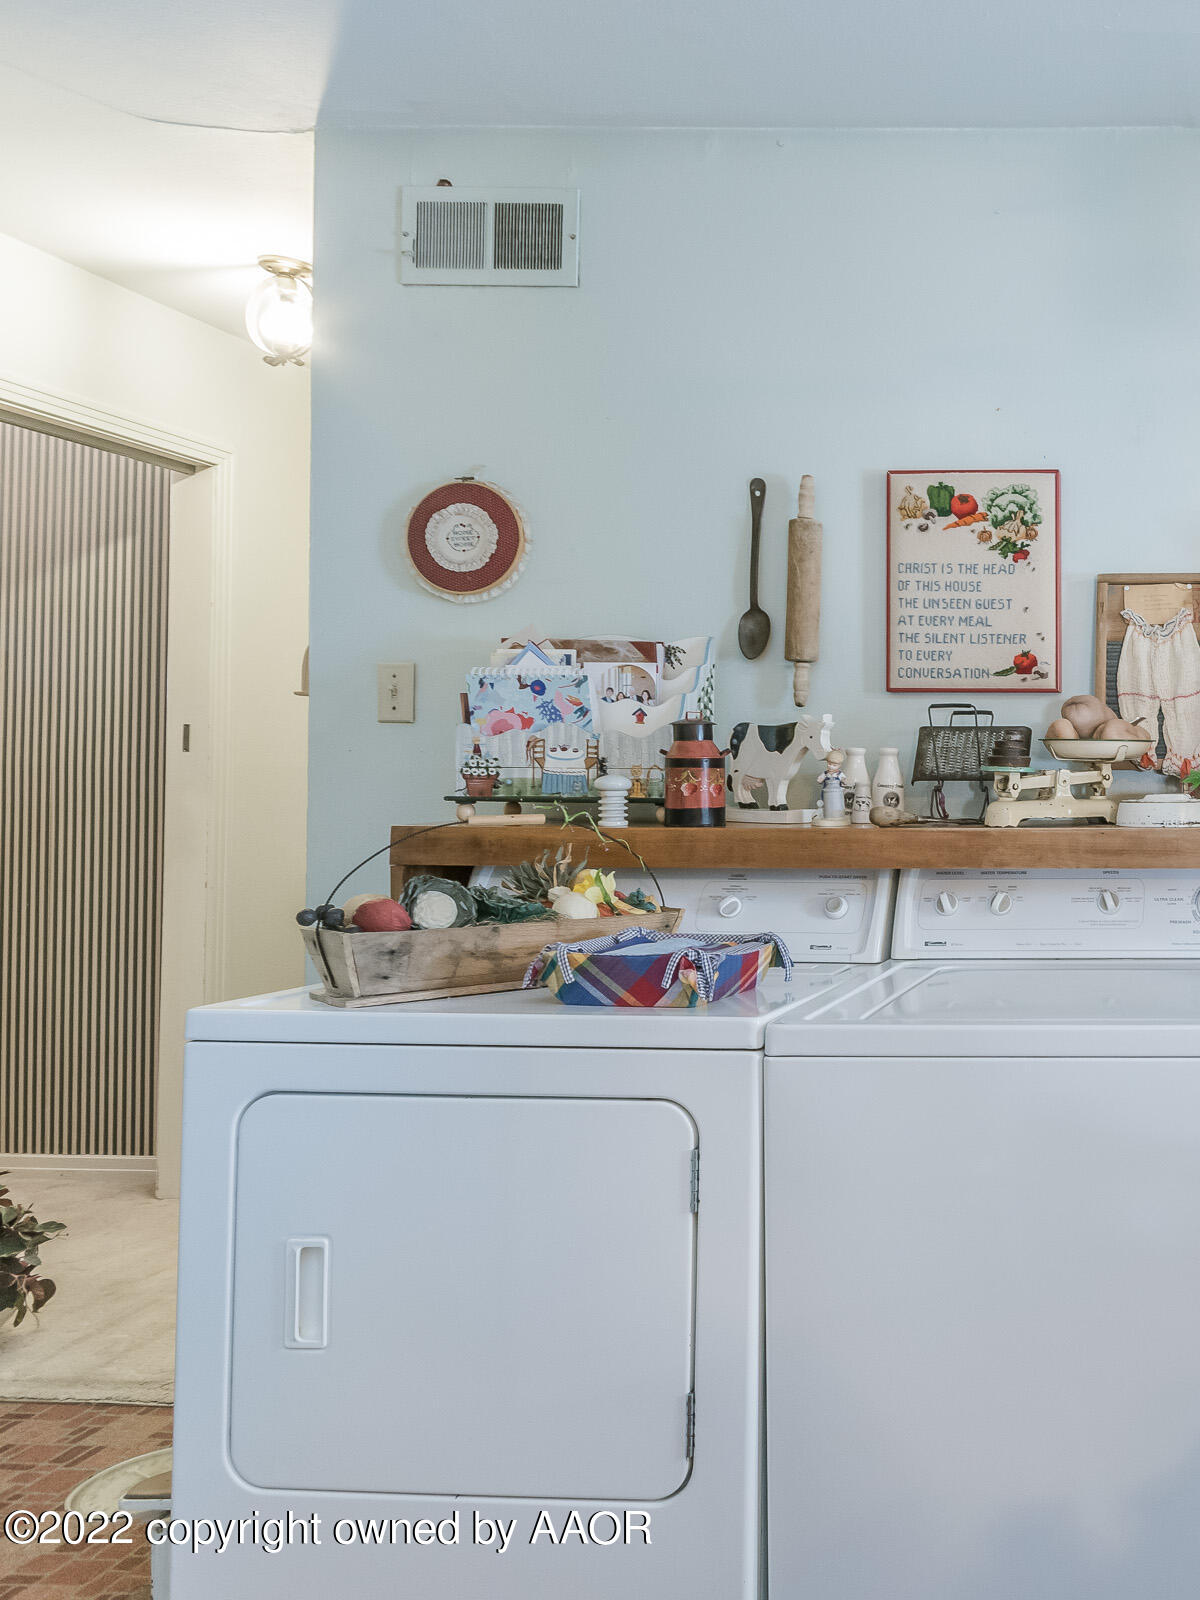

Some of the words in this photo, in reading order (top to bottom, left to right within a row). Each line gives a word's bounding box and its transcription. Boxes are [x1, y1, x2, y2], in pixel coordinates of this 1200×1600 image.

[897, 562, 937, 574] CHRIST
[941, 562, 953, 574] IS
[957, 563, 979, 575] THE
[983, 563, 1016, 575] HEAD
[897, 580, 911, 591] OF
[915, 580, 941, 592] THIS
[944, 580, 982, 592] HOUSE
[898, 597, 919, 609] THE
[923, 598, 972, 609] UNSEEN
[975, 598, 1013, 610] GUEST
[897, 615, 914, 626] AT
[918, 615, 955, 627] EVERY
[958, 615, 993, 627] MEAL
[898, 632, 921, 644] THE
[924, 633, 966, 644] SILENT
[969, 633, 1027, 645] LISTENER
[898, 649, 913, 661] TO
[916, 650, 953, 661] EVERY
[897, 667, 990, 679] CONVERSATION
